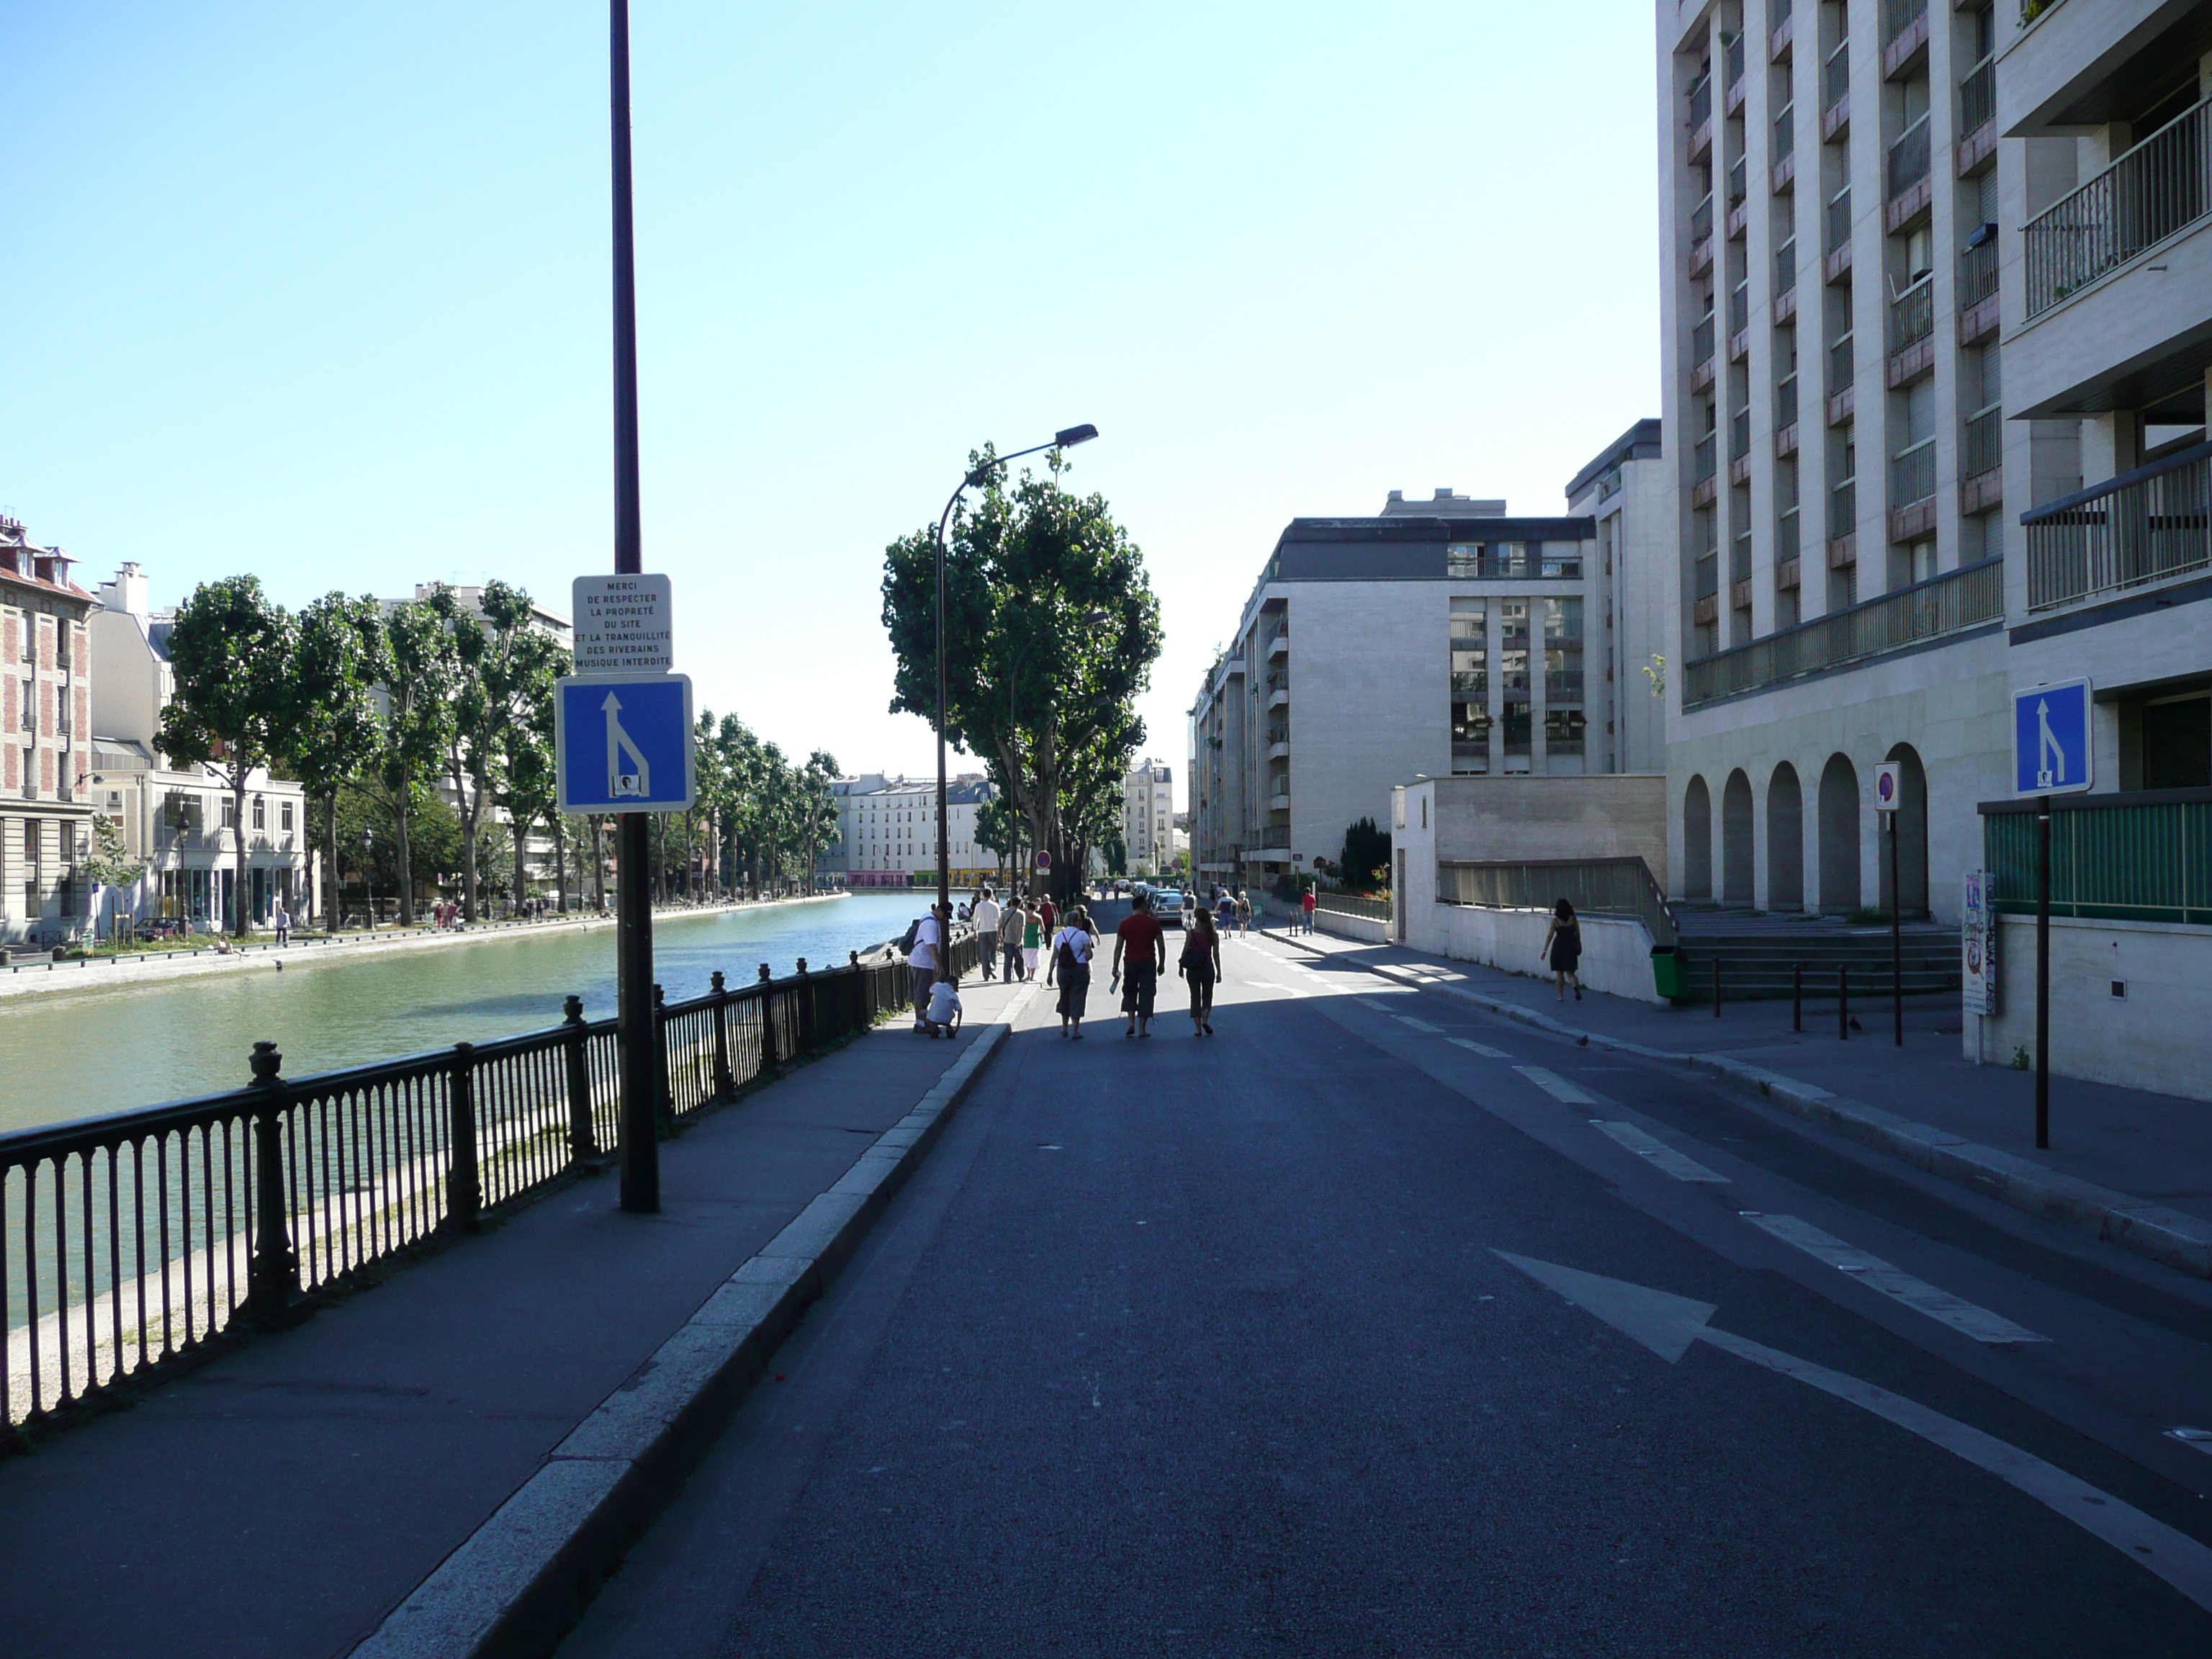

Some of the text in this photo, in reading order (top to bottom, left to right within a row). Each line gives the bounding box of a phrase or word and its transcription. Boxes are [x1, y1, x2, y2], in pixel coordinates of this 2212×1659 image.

[606, 606, 654, 615] PROPRETÉ
[605, 631, 670, 641] TRANQUILLITÉ
[623, 657, 670, 666] INTERDITE
